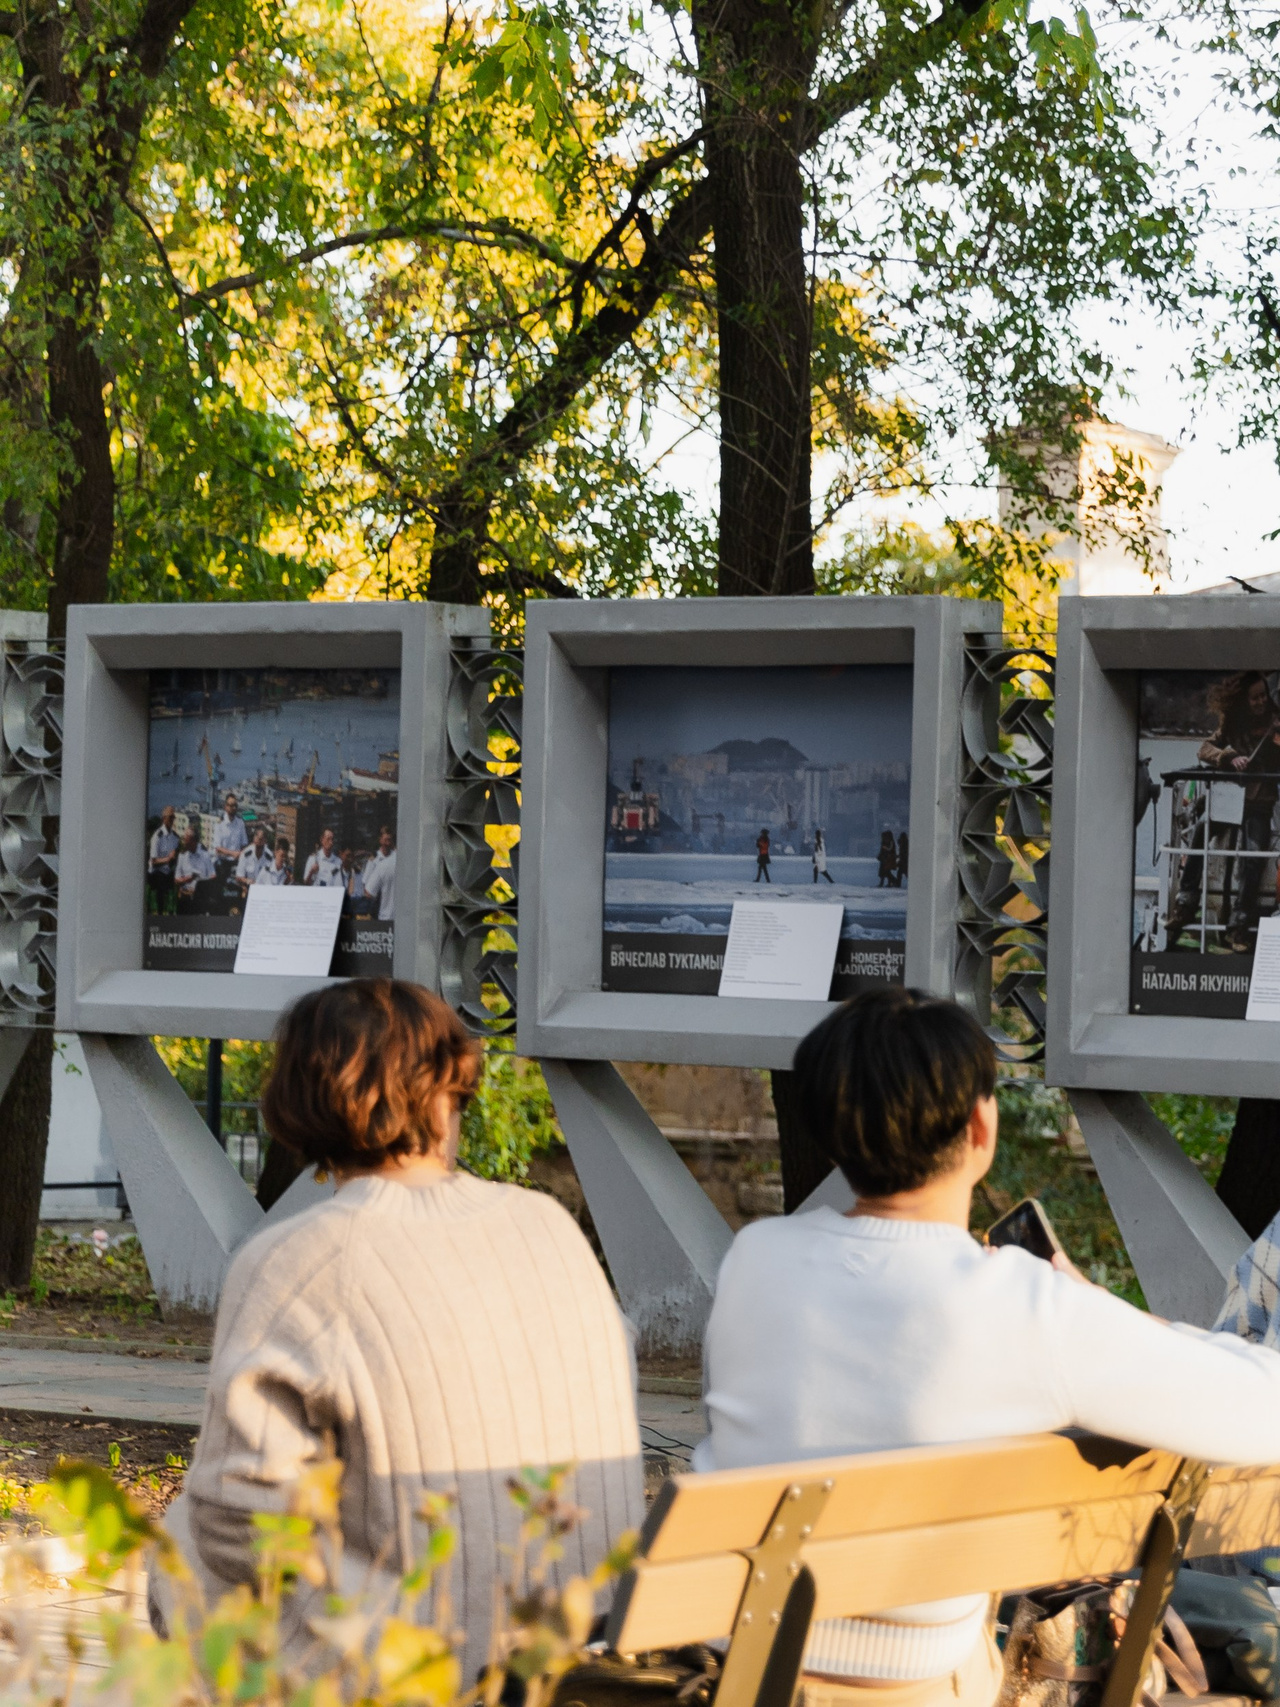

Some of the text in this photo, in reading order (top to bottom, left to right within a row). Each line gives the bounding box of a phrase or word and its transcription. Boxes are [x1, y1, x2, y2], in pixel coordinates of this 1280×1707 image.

[202, 934, 241, 950] КОТЛЯР
[610, 950, 667, 969] ВЯЧЕСЛАВ
[850, 951, 905, 965] HOMEPORT
[1142, 972, 1250, 993] НАТАЛЬЯ ЯКУНИН
